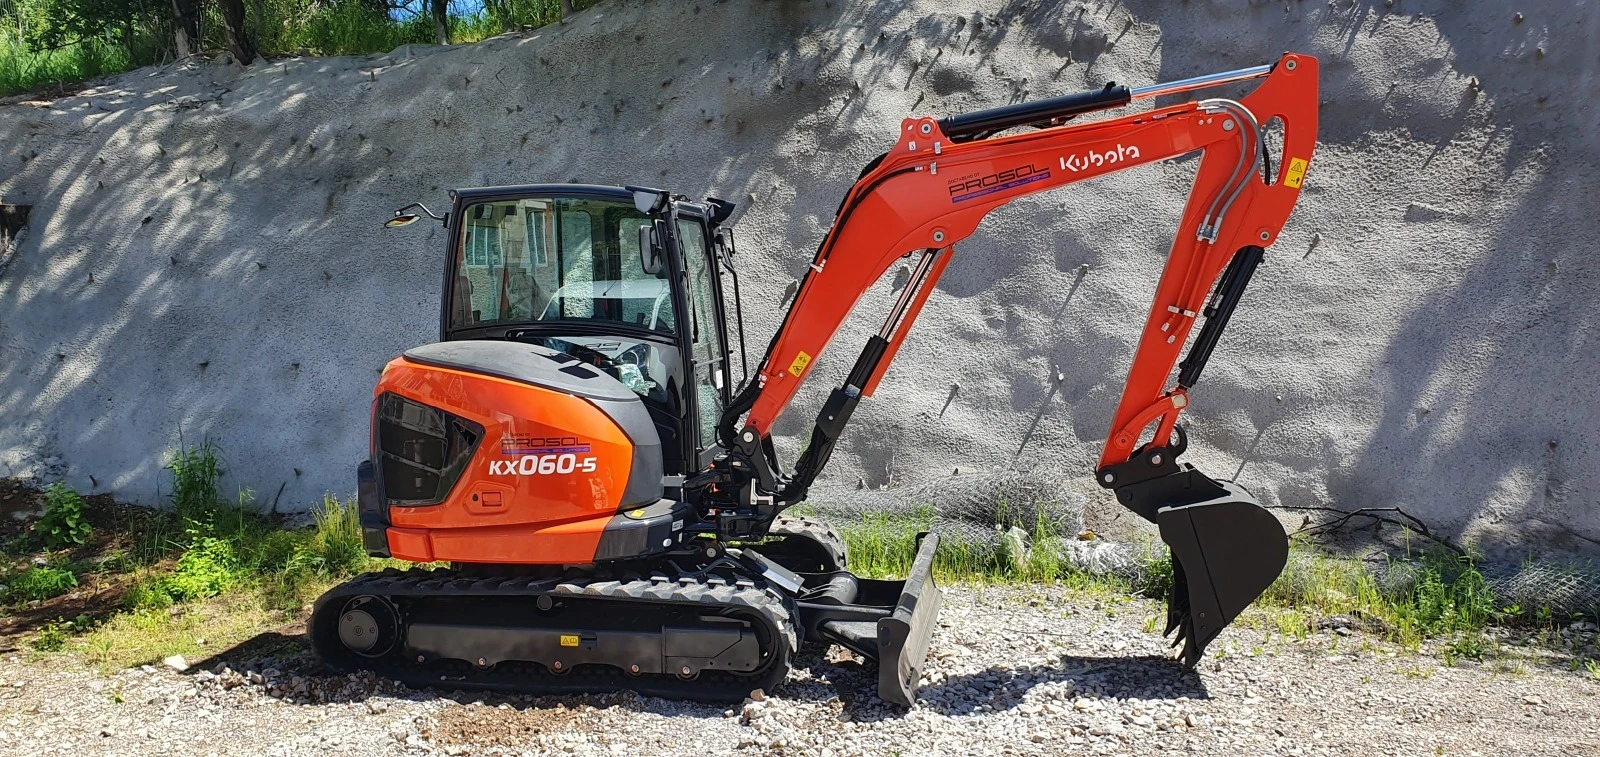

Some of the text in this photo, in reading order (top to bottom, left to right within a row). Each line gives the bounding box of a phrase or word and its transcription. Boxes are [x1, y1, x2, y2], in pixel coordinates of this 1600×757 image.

[1059, 143, 1140, 172] Kubota
[949, 163, 1049, 196] PROSOL
[502, 437, 590, 447] PROSOL
[489, 454, 597, 475] KX060-5
